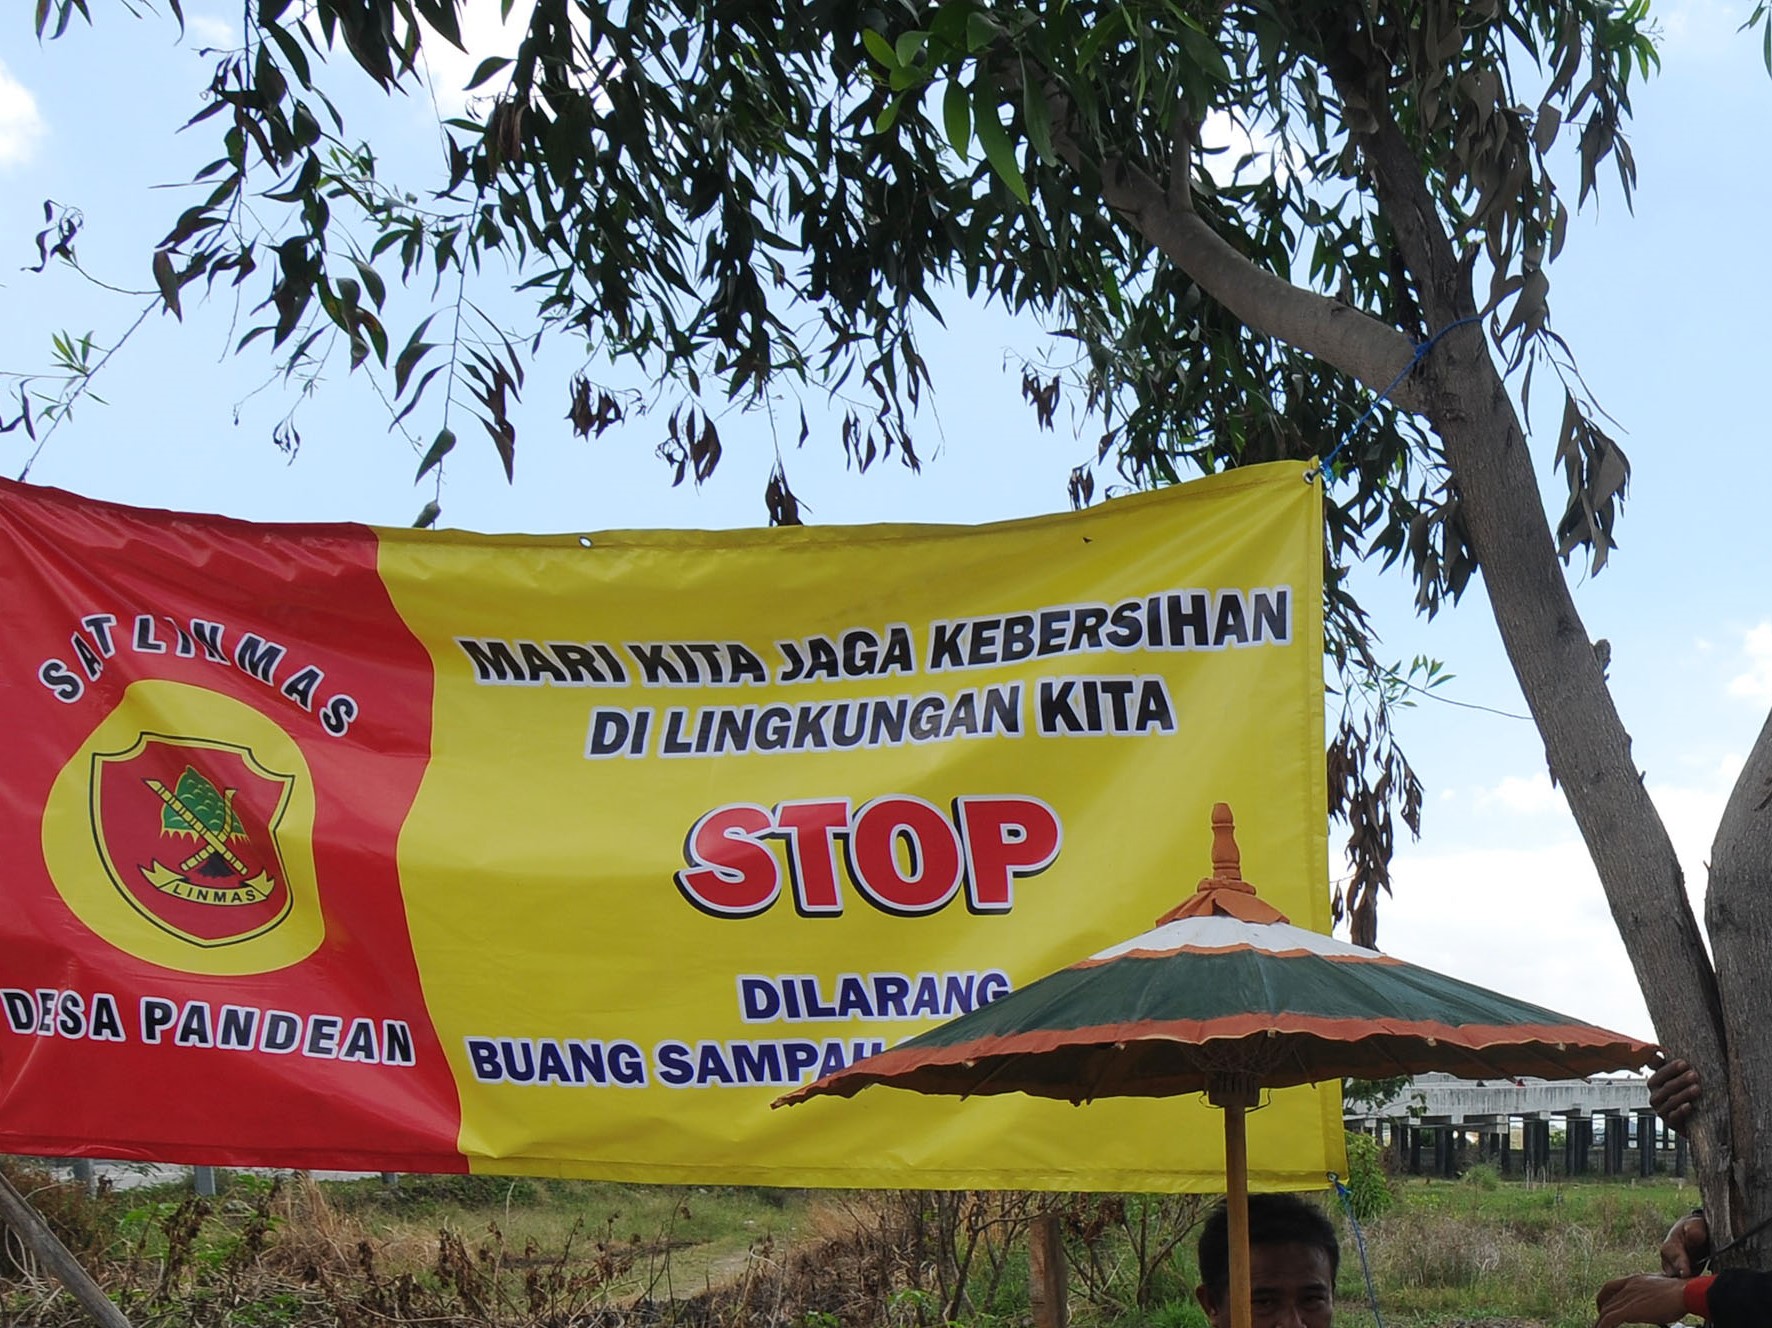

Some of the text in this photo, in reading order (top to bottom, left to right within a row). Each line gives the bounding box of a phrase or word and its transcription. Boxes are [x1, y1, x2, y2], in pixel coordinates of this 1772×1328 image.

[454, 585, 1294, 690] MARI KITA JAGA KEBERSIHAN
[584, 675, 1179, 761] DI LINGKUNGAN KITA
[171, 882, 257, 905] LINMAS
[675, 795, 1064, 918] STOP
[1, 987, 417, 1067] DESA PANDEAN
[736, 970, 1012, 1025] DILARANG
[464, 1036, 650, 1088] BUANG
